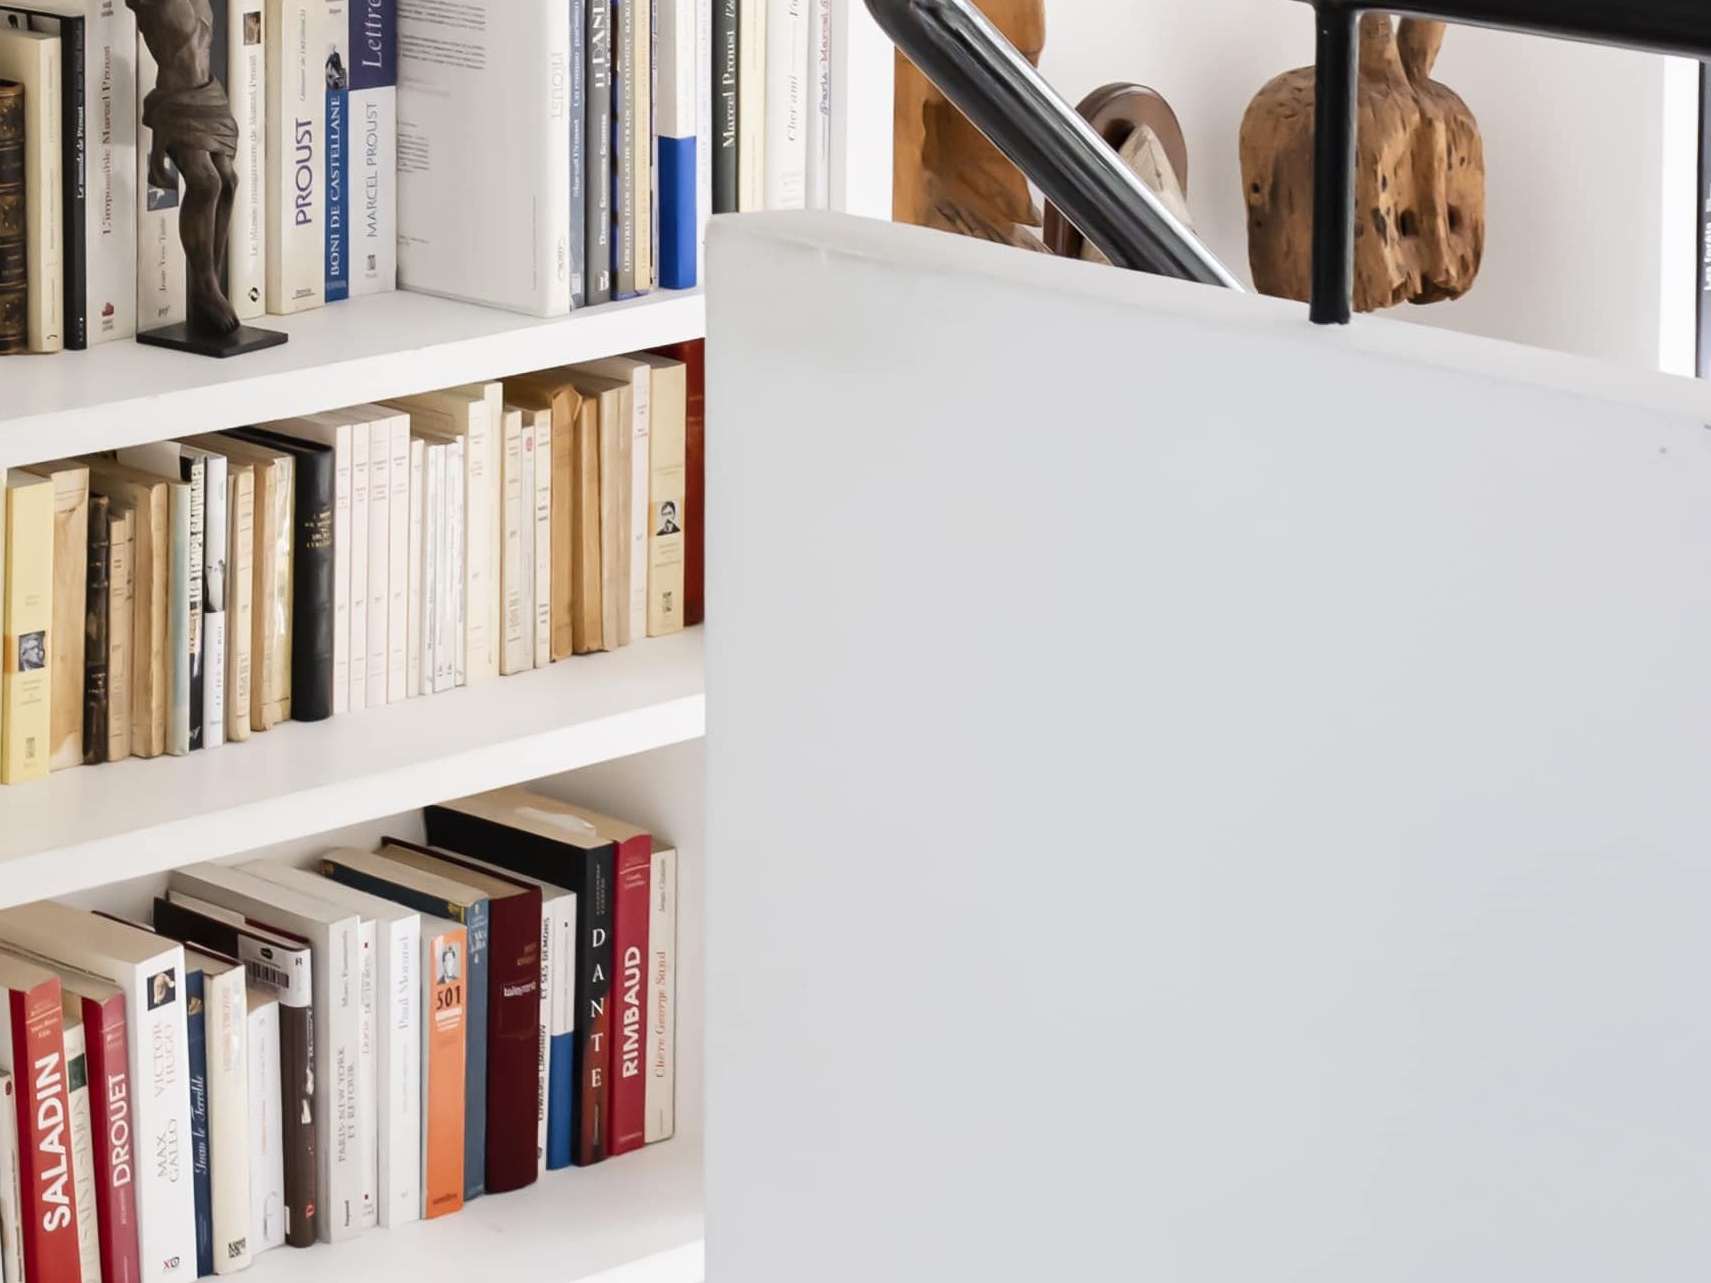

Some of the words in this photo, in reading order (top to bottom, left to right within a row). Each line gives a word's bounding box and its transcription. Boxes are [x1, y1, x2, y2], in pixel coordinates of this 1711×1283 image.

[329, 95, 341, 202] CASTELLANE
[366, 101, 378, 166] PROUST
[294, 116, 313, 228] PROUST
[366, 170, 378, 238] MARCEL
[329, 205, 341, 229] DE
[329, 233, 341, 276] BONI
[436, 984, 462, 1011] 501
[591, 928, 606, 1088] DANTE
[622, 945, 641, 1078] RIMBAUD
[36, 1051, 72, 1232] SALADIN
[108, 1072, 132, 1189] DROUET
[157, 1131, 169, 1180] MAX
[168, 1118, 180, 1184] GALLO
